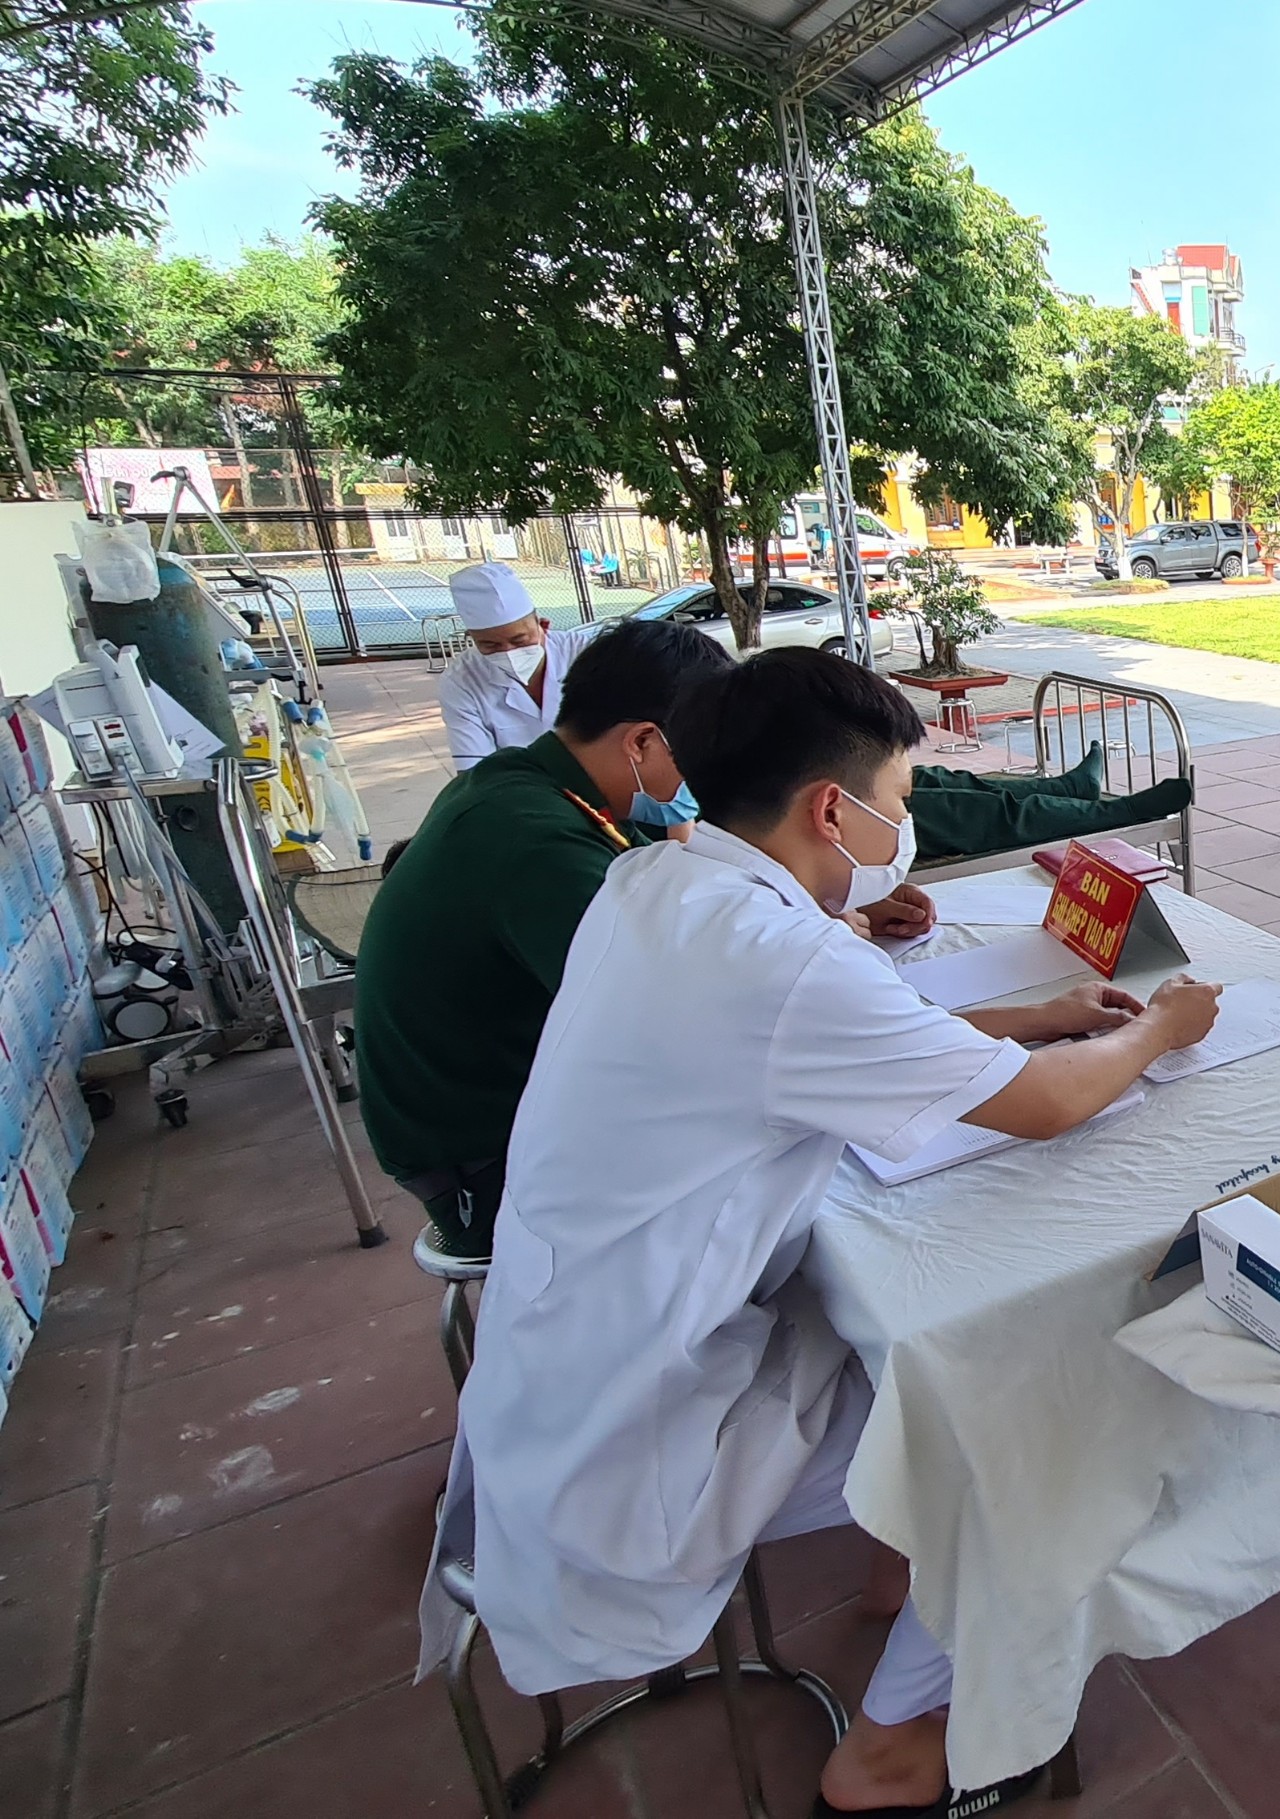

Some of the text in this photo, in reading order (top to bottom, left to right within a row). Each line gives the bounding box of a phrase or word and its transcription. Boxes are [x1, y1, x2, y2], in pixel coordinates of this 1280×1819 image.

[1080, 870, 1111, 905] BÀN
[1052, 892, 1070, 924] GHI
[1065, 901, 1088, 937] CHÉP
[1084, 912, 1104, 950] VÀO
[1215, 1163, 1270, 1194] hospital
